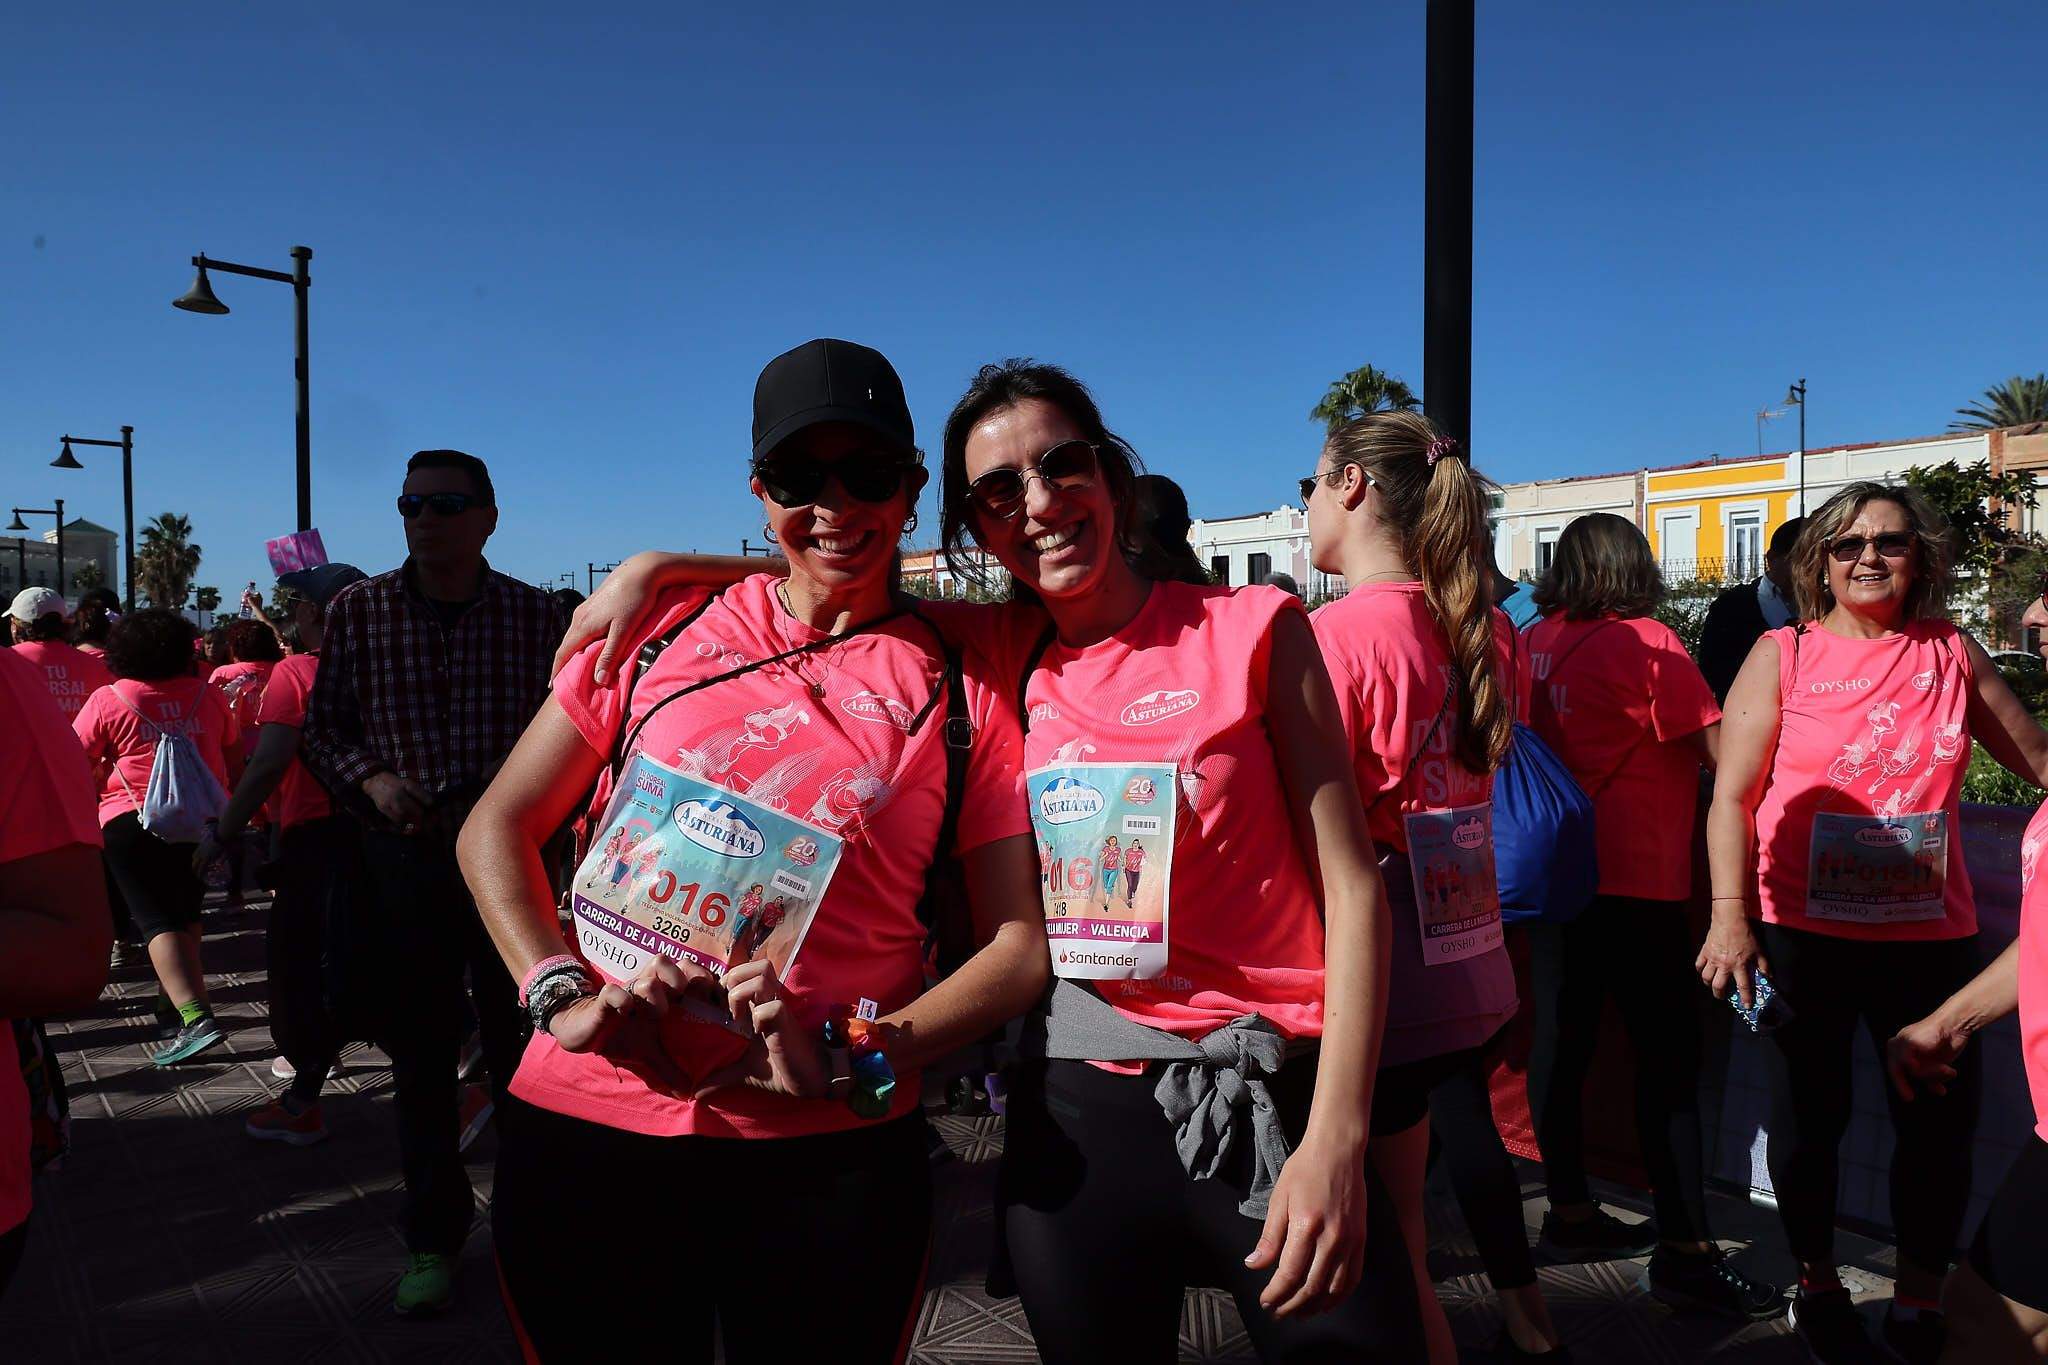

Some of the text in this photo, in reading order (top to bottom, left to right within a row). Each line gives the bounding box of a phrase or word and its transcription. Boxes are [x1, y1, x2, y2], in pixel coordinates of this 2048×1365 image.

[1811, 678, 1871, 694] OYSHO
[157, 701, 182, 719] TU
[1127, 697, 1193, 722] ASTURIANA
[635, 777, 664, 800] SUMA
[678, 806, 757, 855] ASTURIANA
[1860, 832, 1909, 842] ASTURIANA
[791, 836, 817, 857] 20
[648, 869, 731, 928] 016
[579, 902, 622, 934] CARRERA
[624, 925, 641, 943] DE
[641, 935, 655, 950] LA
[652, 916, 691, 943] 3269
[1090, 923, 1150, 939] VALENCIA
[1431, 921, 1463, 935] CARRERA
[582, 930, 638, 970] OYSHO
[1441, 937, 1475, 954] OYSHO
[1069, 950, 1139, 967] Santander
